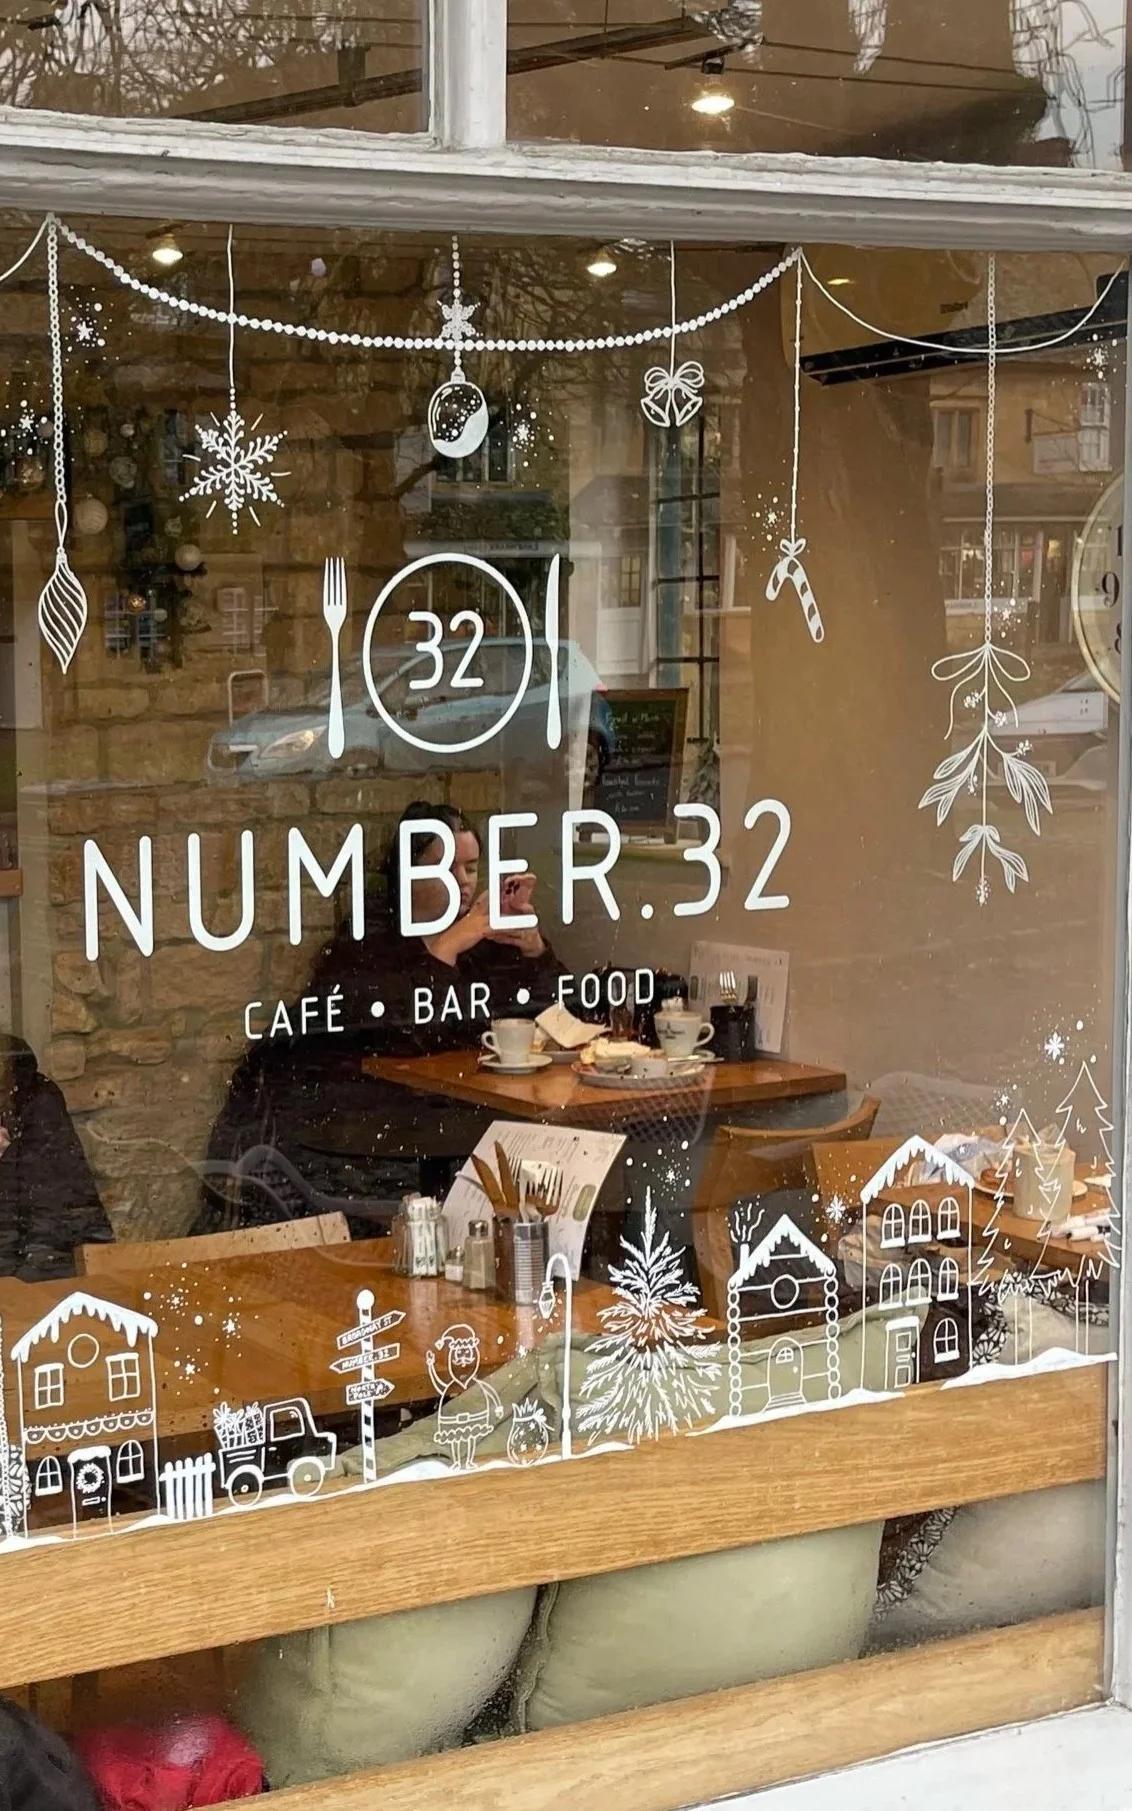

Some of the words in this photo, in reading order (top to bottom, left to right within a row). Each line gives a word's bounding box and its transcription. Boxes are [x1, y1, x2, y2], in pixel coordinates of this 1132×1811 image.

[1101, 571, 1120, 608] 9
[408, 610, 485, 690] 32
[84, 798, 792, 962] NUMBER.32
[244, 983, 345, 1040] CAFÉ
[413, 982, 491, 1024] BAR
[557, 968, 655, 1010] FOOD
[341, 1323, 382, 1345] BROADWAY
